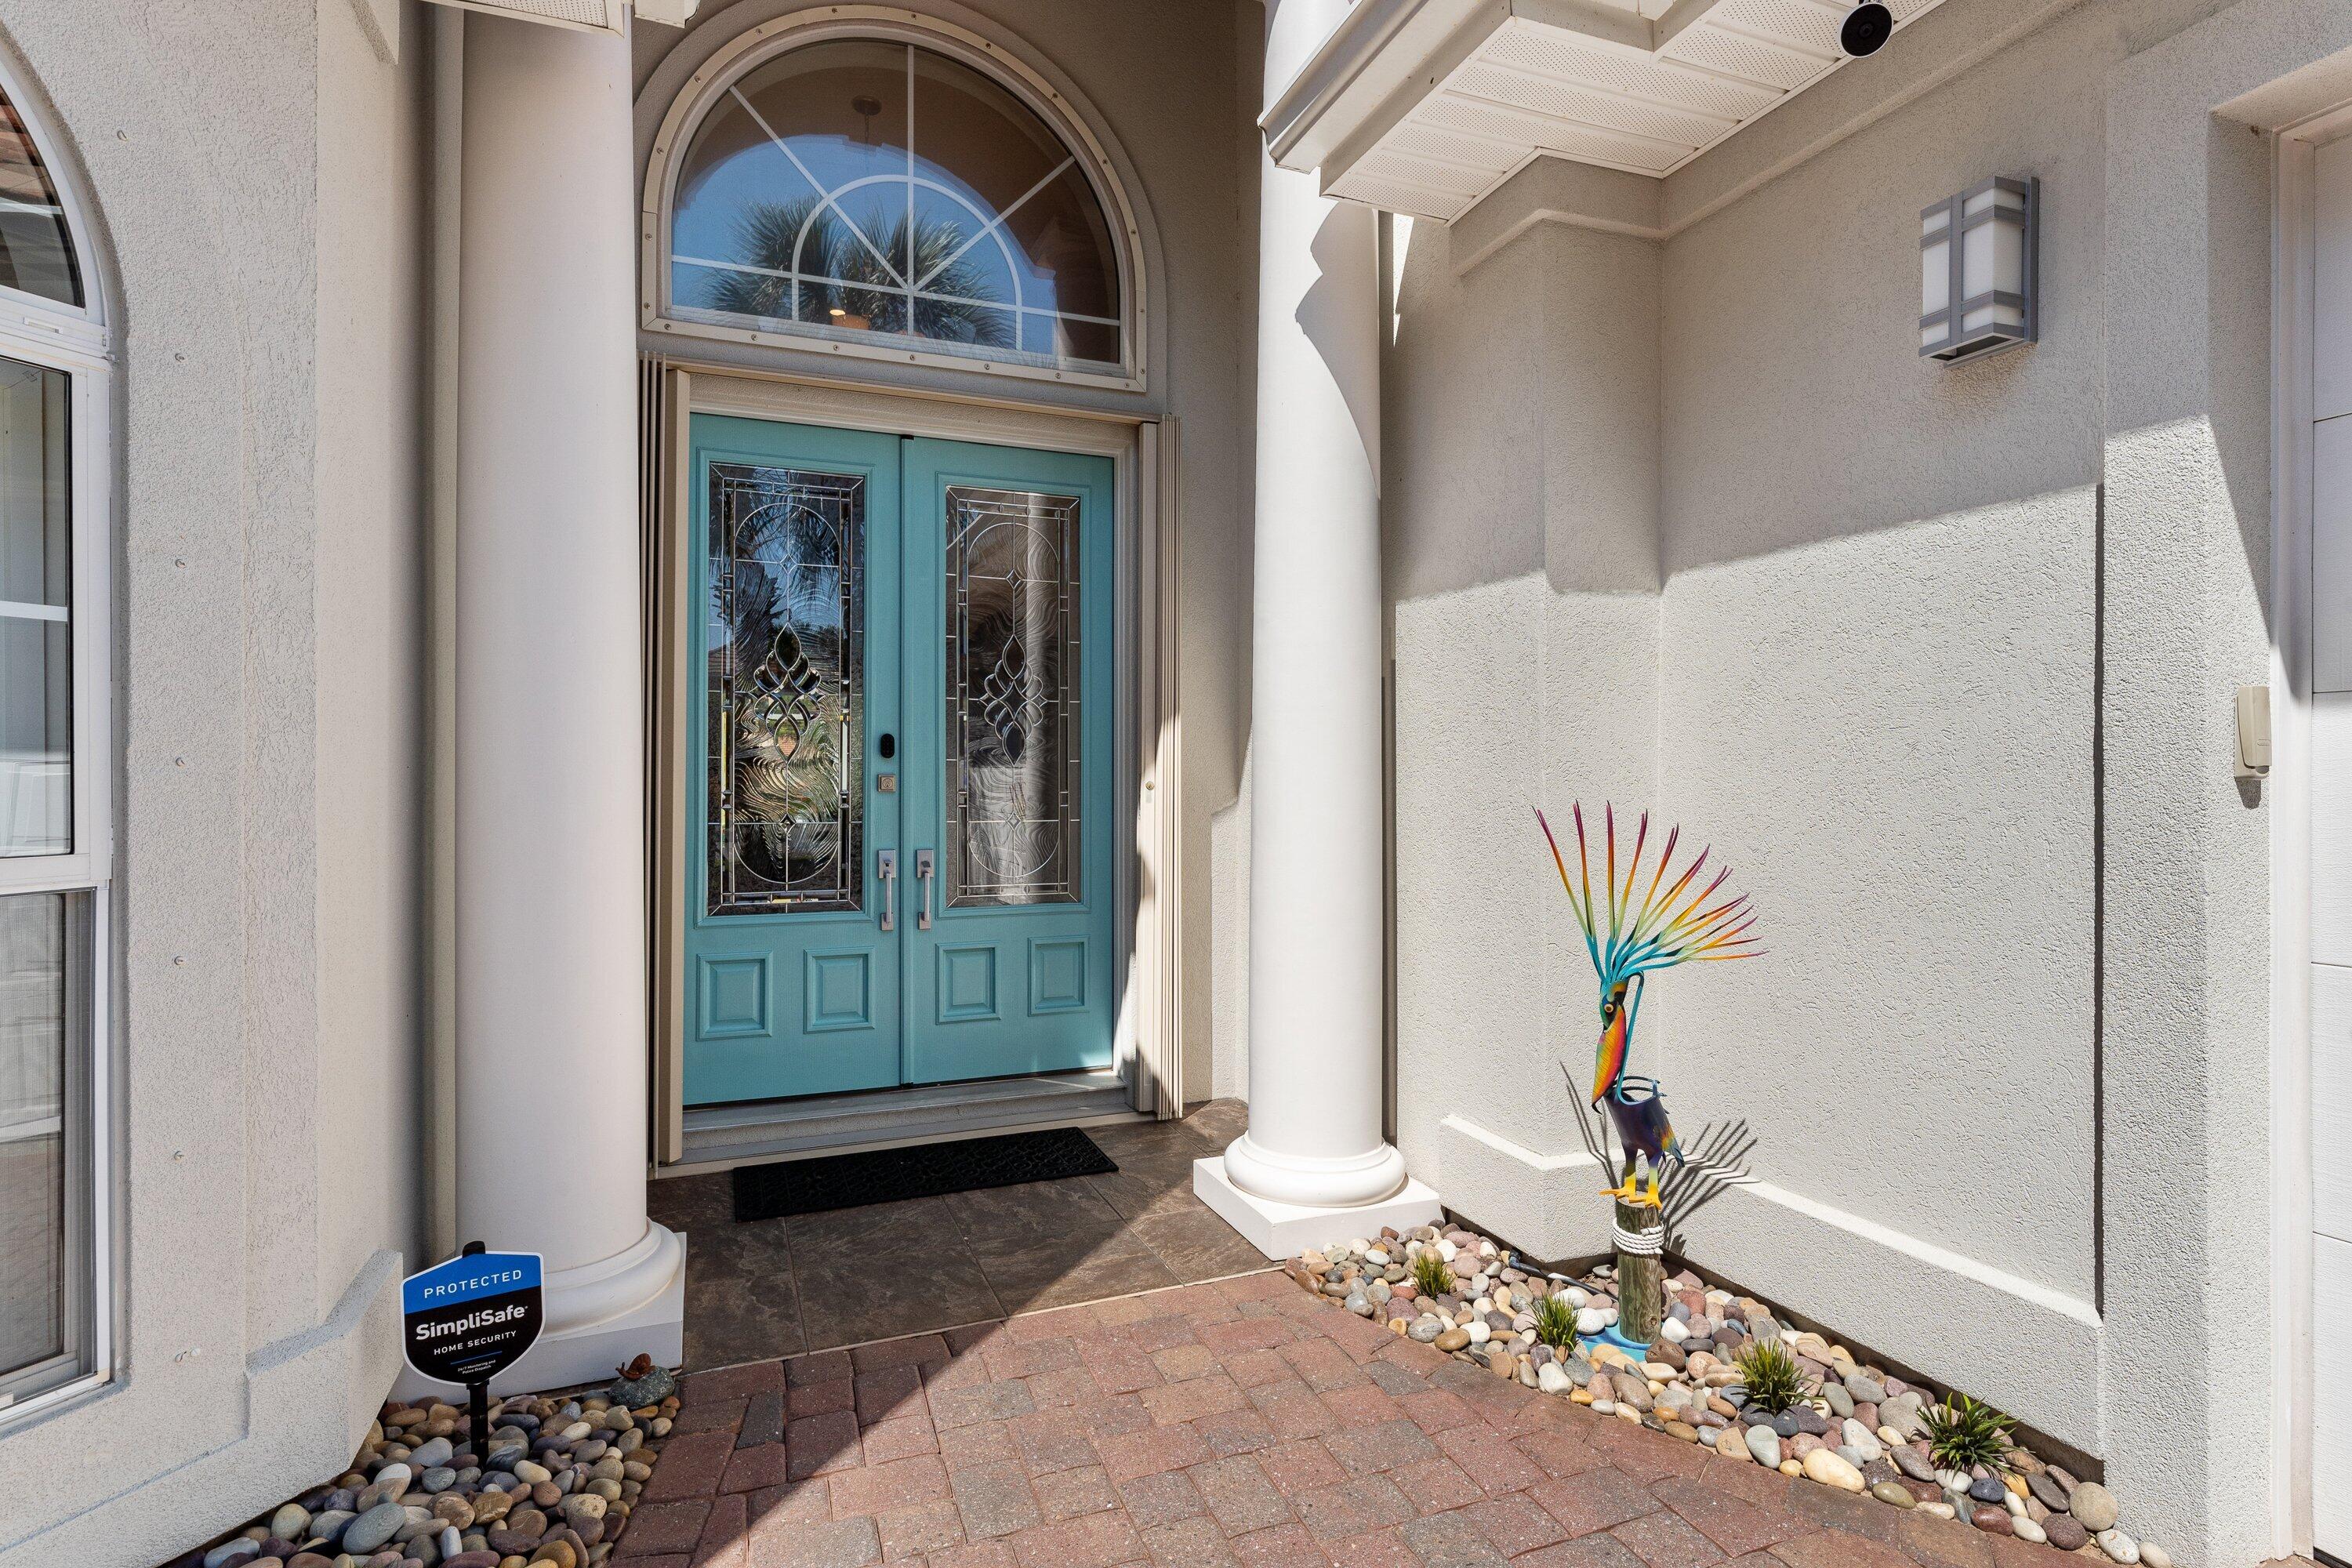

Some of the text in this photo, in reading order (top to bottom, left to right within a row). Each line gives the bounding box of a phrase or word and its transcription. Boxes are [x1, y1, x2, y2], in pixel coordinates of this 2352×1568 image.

[424, 1269, 522, 1299] PROTECTED
[416, 1305, 526, 1340] SimpliSafe
[434, 1330, 517, 1356] HOME SECURITY
